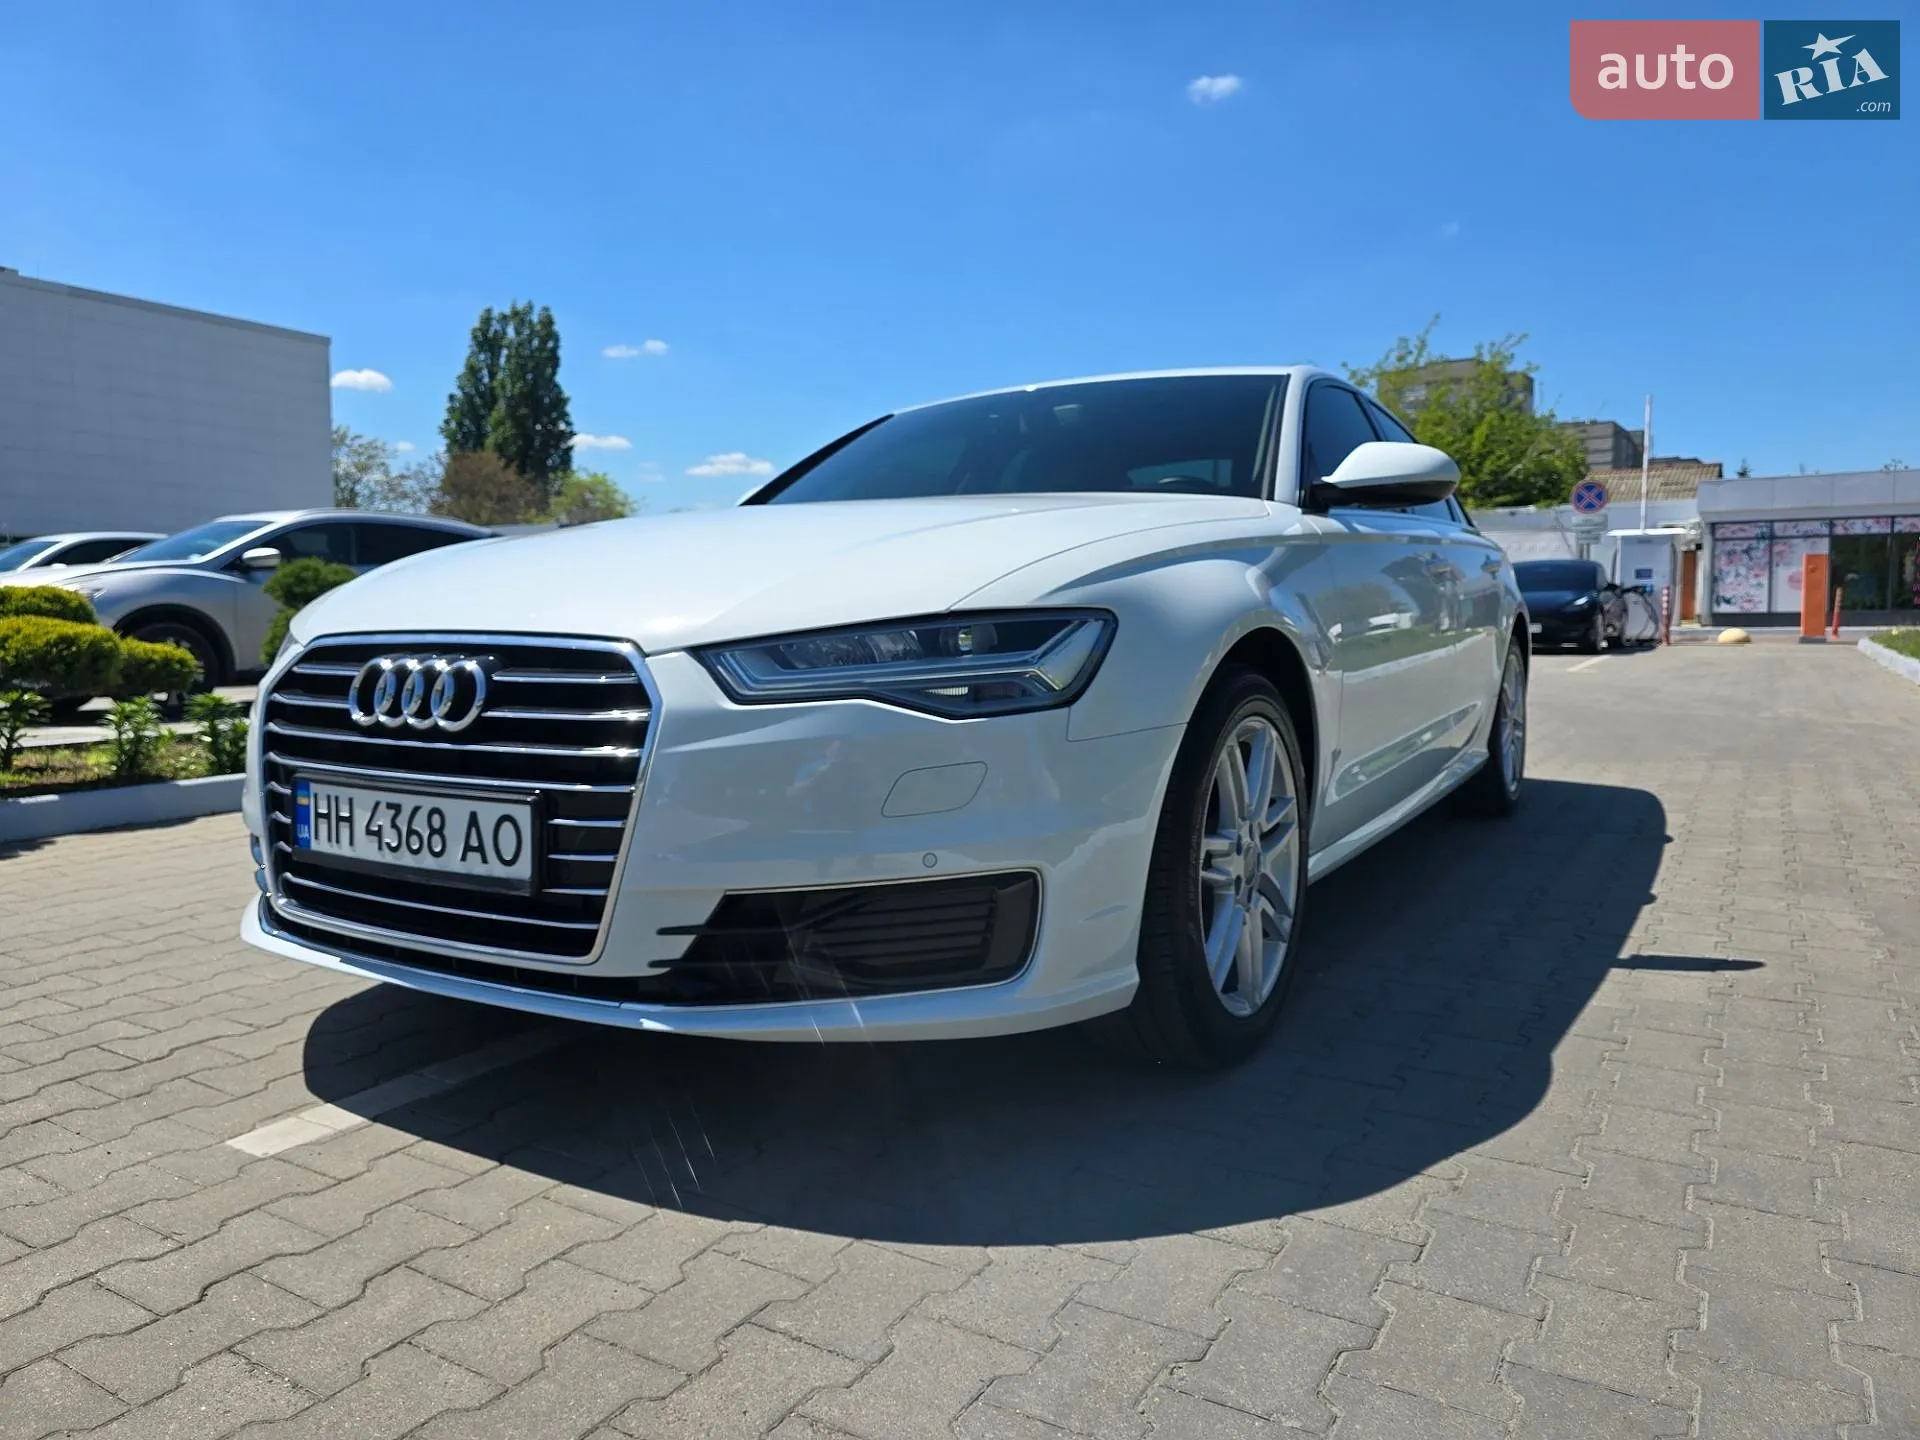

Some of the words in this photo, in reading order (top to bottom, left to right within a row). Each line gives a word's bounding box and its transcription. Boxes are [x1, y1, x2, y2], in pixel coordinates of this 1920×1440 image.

[296, 823, 310, 840] UA
[313, 792, 354, 847] HH
[365, 800, 447, 858] 4368
[459, 810, 522, 867] AO
